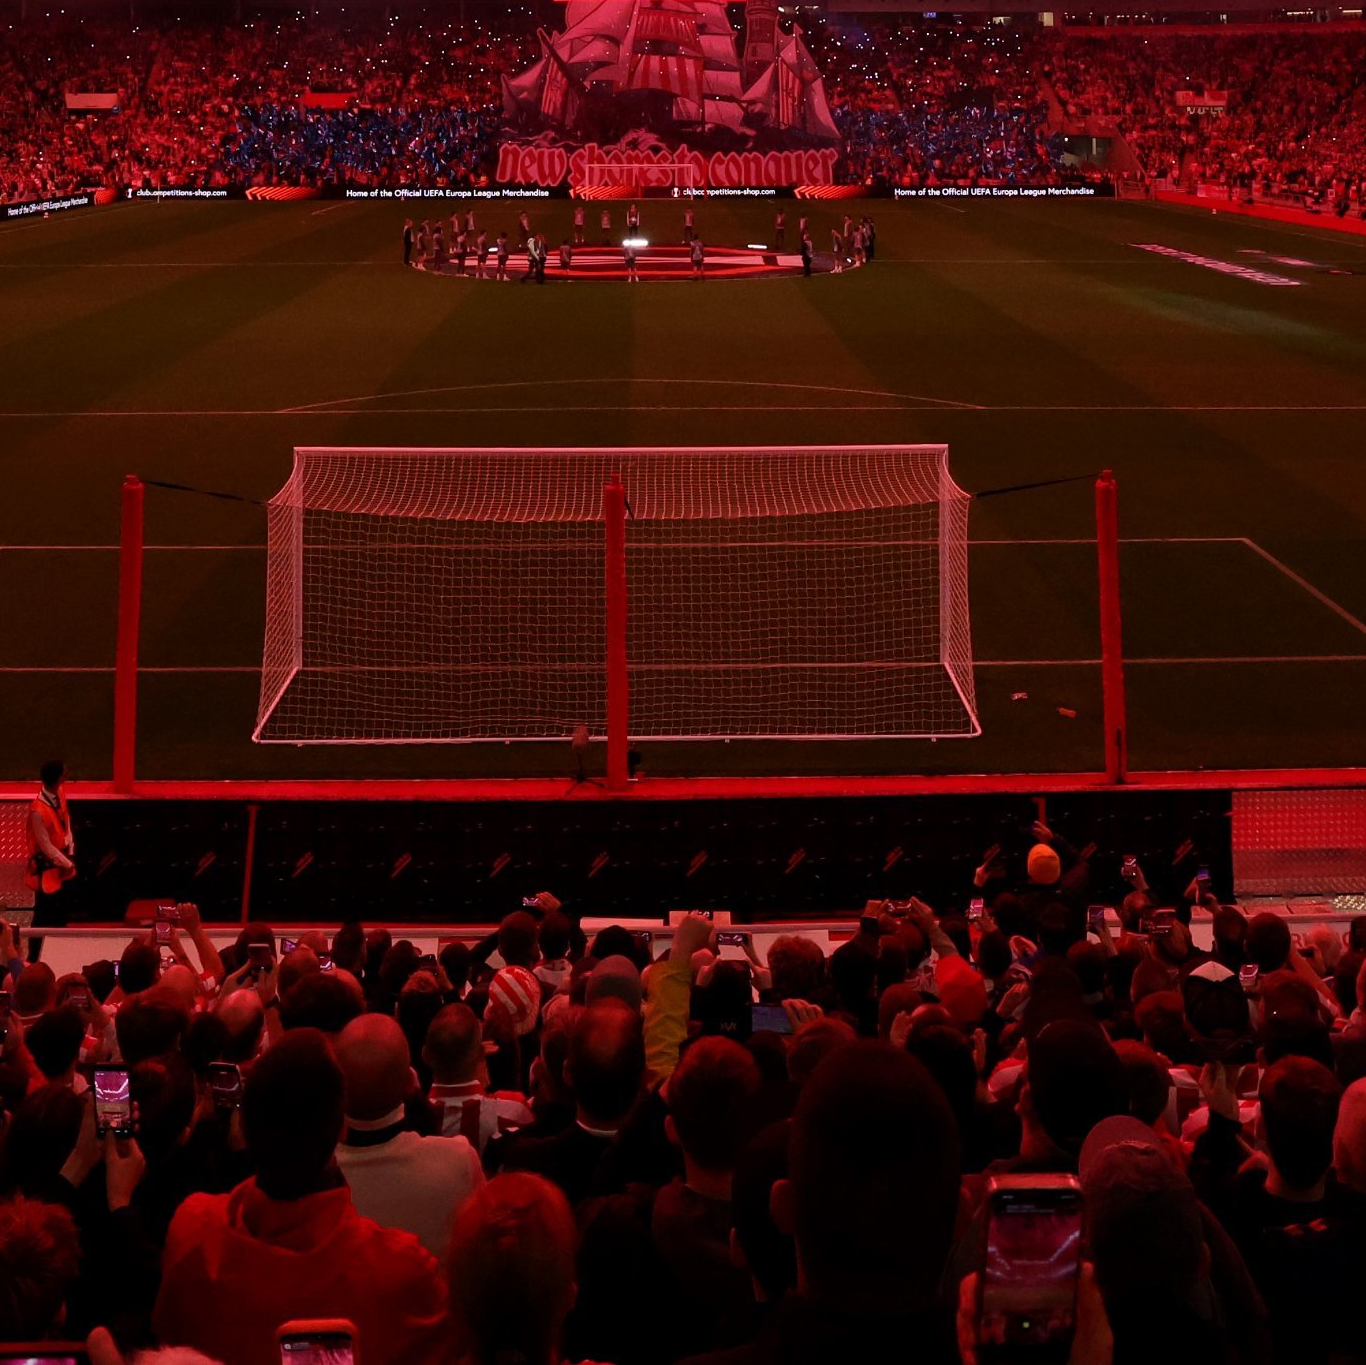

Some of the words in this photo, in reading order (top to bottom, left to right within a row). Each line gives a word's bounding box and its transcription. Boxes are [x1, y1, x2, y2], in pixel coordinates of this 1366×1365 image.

[497, 142, 566, 186] new
[708, 147, 838, 186] conquer
[346, 189, 369, 198] Home
[370, 189, 379, 198] of
[380, 189, 393, 198] the
[394, 189, 422, 198] Official
[424, 189, 444, 198] UEFA
[446, 189, 472, 199] Europa
[474, 189, 500, 199] League
[502, 188, 549, 197] Merchandise
[894, 187, 916, 196] Home
[918, 187, 927, 196] of
[928, 187, 941, 196] the
[942, 187, 969, 196] Official
[971, 187, 991, 196] UEFA
[993, 187, 1019, 197] Europa
[1020, 187, 1046, 197] League
[1048, 186, 1094, 196] Merchandise
